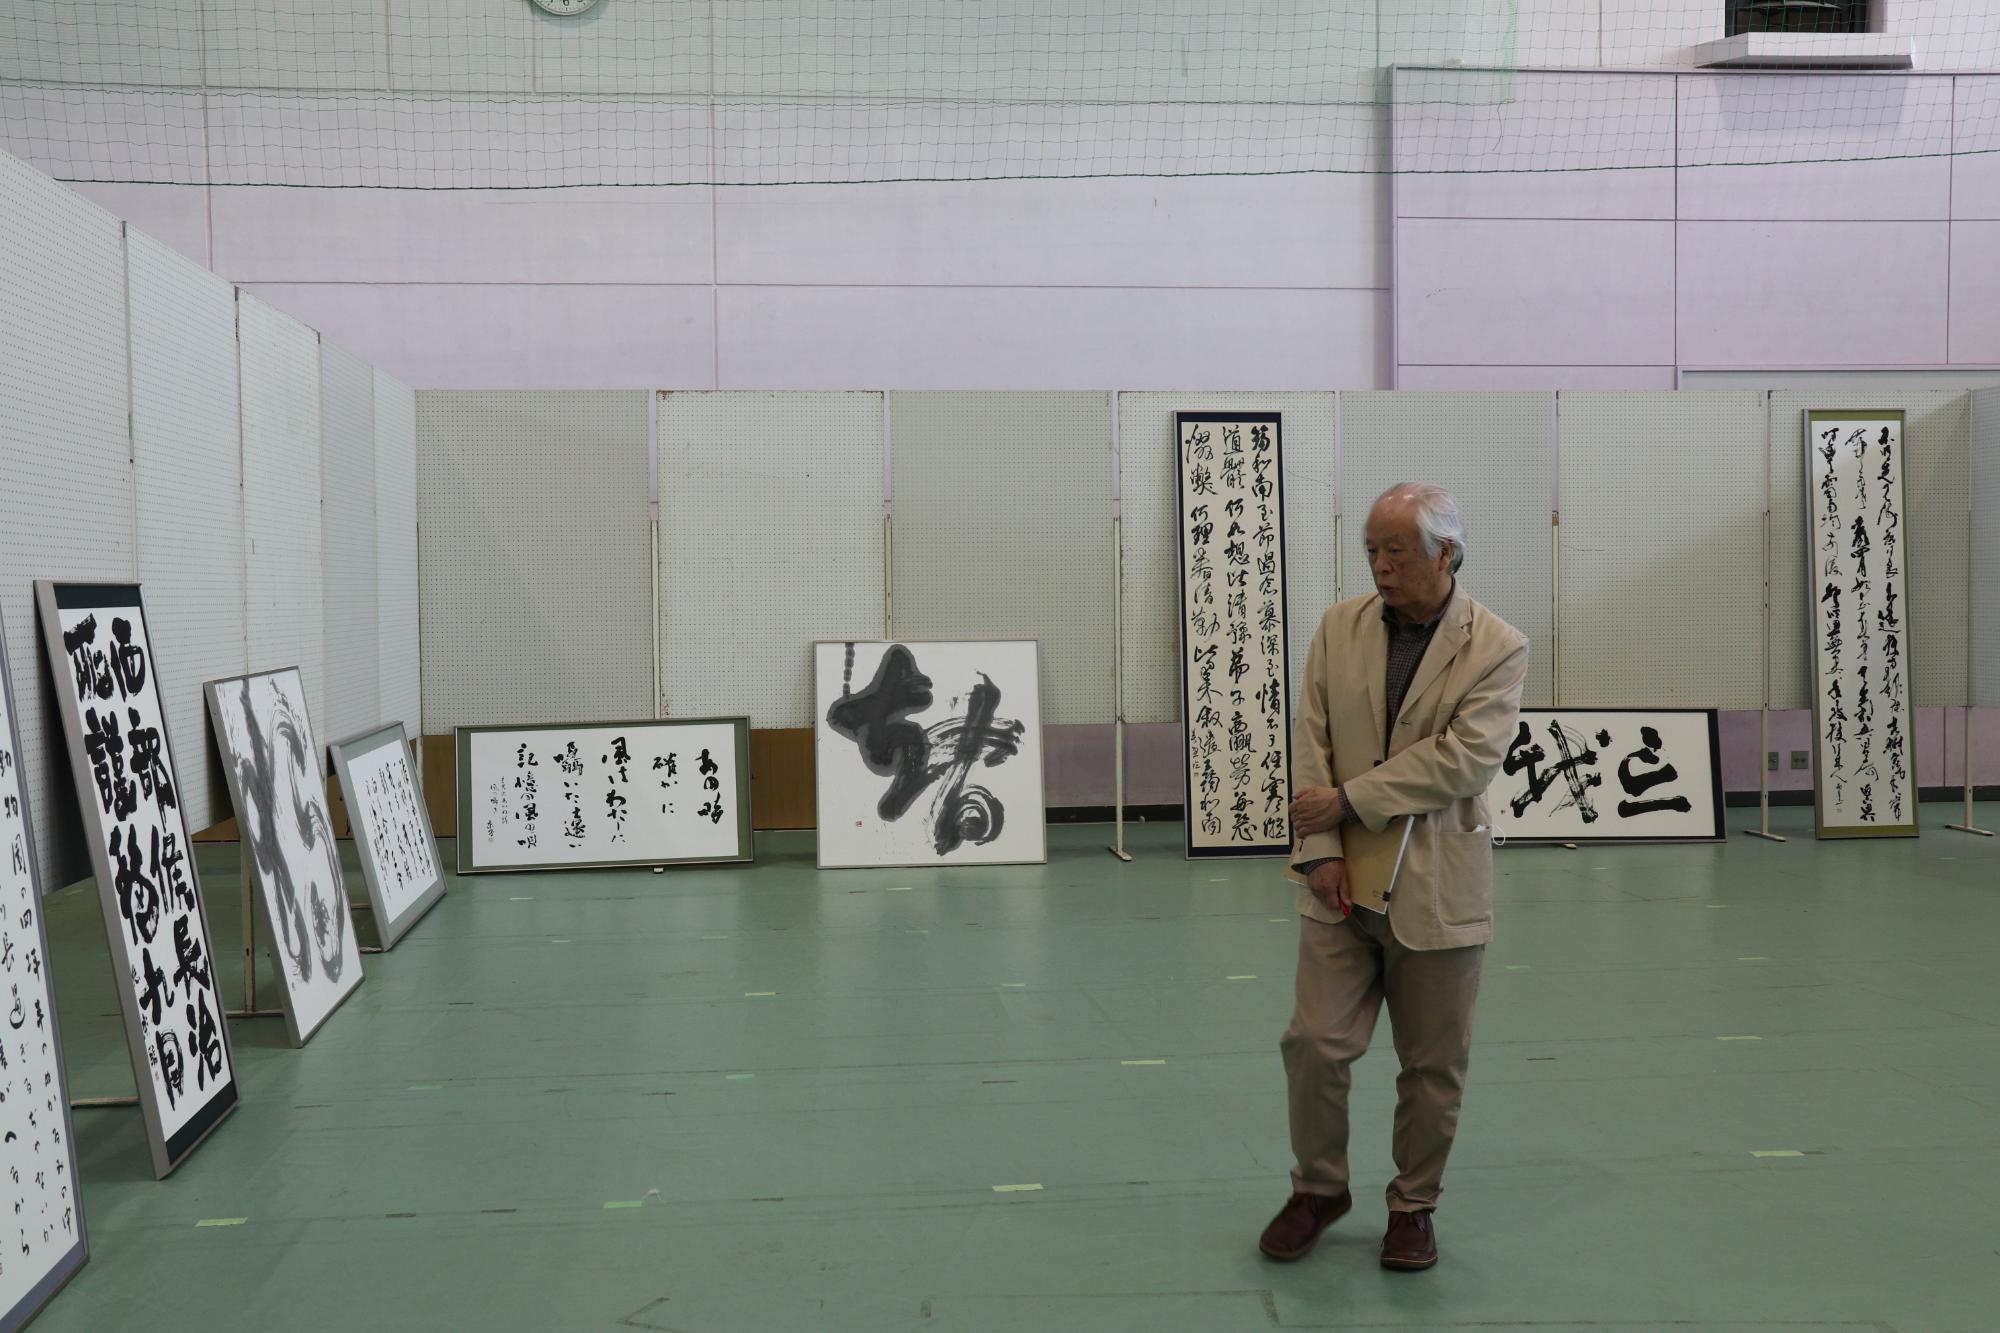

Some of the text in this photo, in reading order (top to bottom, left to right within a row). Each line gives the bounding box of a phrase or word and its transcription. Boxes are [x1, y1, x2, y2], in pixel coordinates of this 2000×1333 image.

[601, 736, 632, 844] 風はわたしに
[653, 752, 678, 815] 確かに
[694, 748, 725, 825] あの時
